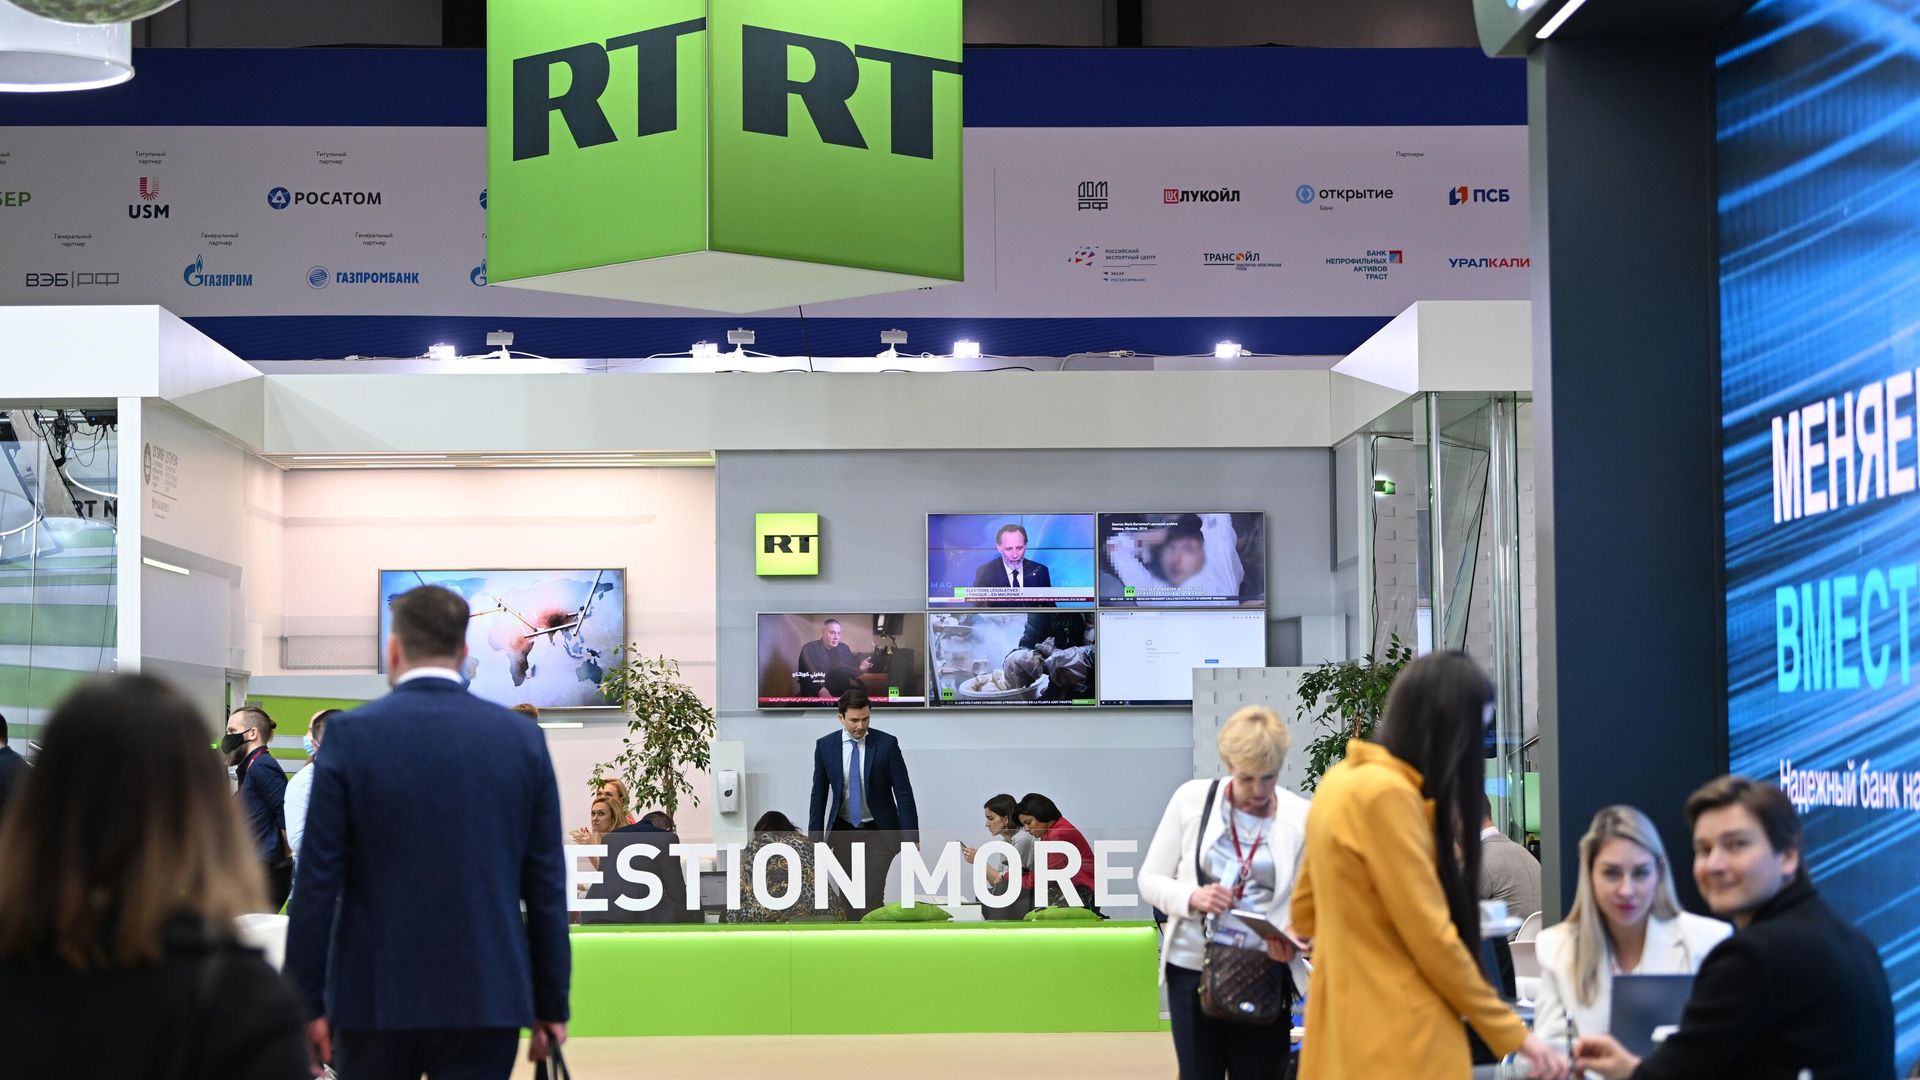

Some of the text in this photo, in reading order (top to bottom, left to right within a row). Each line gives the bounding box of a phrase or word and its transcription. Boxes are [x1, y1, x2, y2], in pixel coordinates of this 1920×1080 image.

[513, 17, 706, 161] RT
[742, 24, 964, 160] RT
[294, 191, 382, 205] РОСАТОМ
[1179, 187, 1240, 203] ЛУКОЙЛ
[1319, 188, 1393, 202] открытие
[1473, 188, 1510, 203] ПСБ
[128, 204, 170, 219] USM
[26, 272, 119, 287] ВЭБ РФ
[203, 274, 253, 287] ГАЗПРОМ
[336, 272, 419, 284] ГАЗПРОМБАНК
[764, 534, 818, 553] RT
[1776, 563, 1920, 693] ВМЕСТ
[1780, 758, 1858, 814] Надежный
[1860, 759, 1899, 809] банк
[900, 840, 1139, 909] MORE
